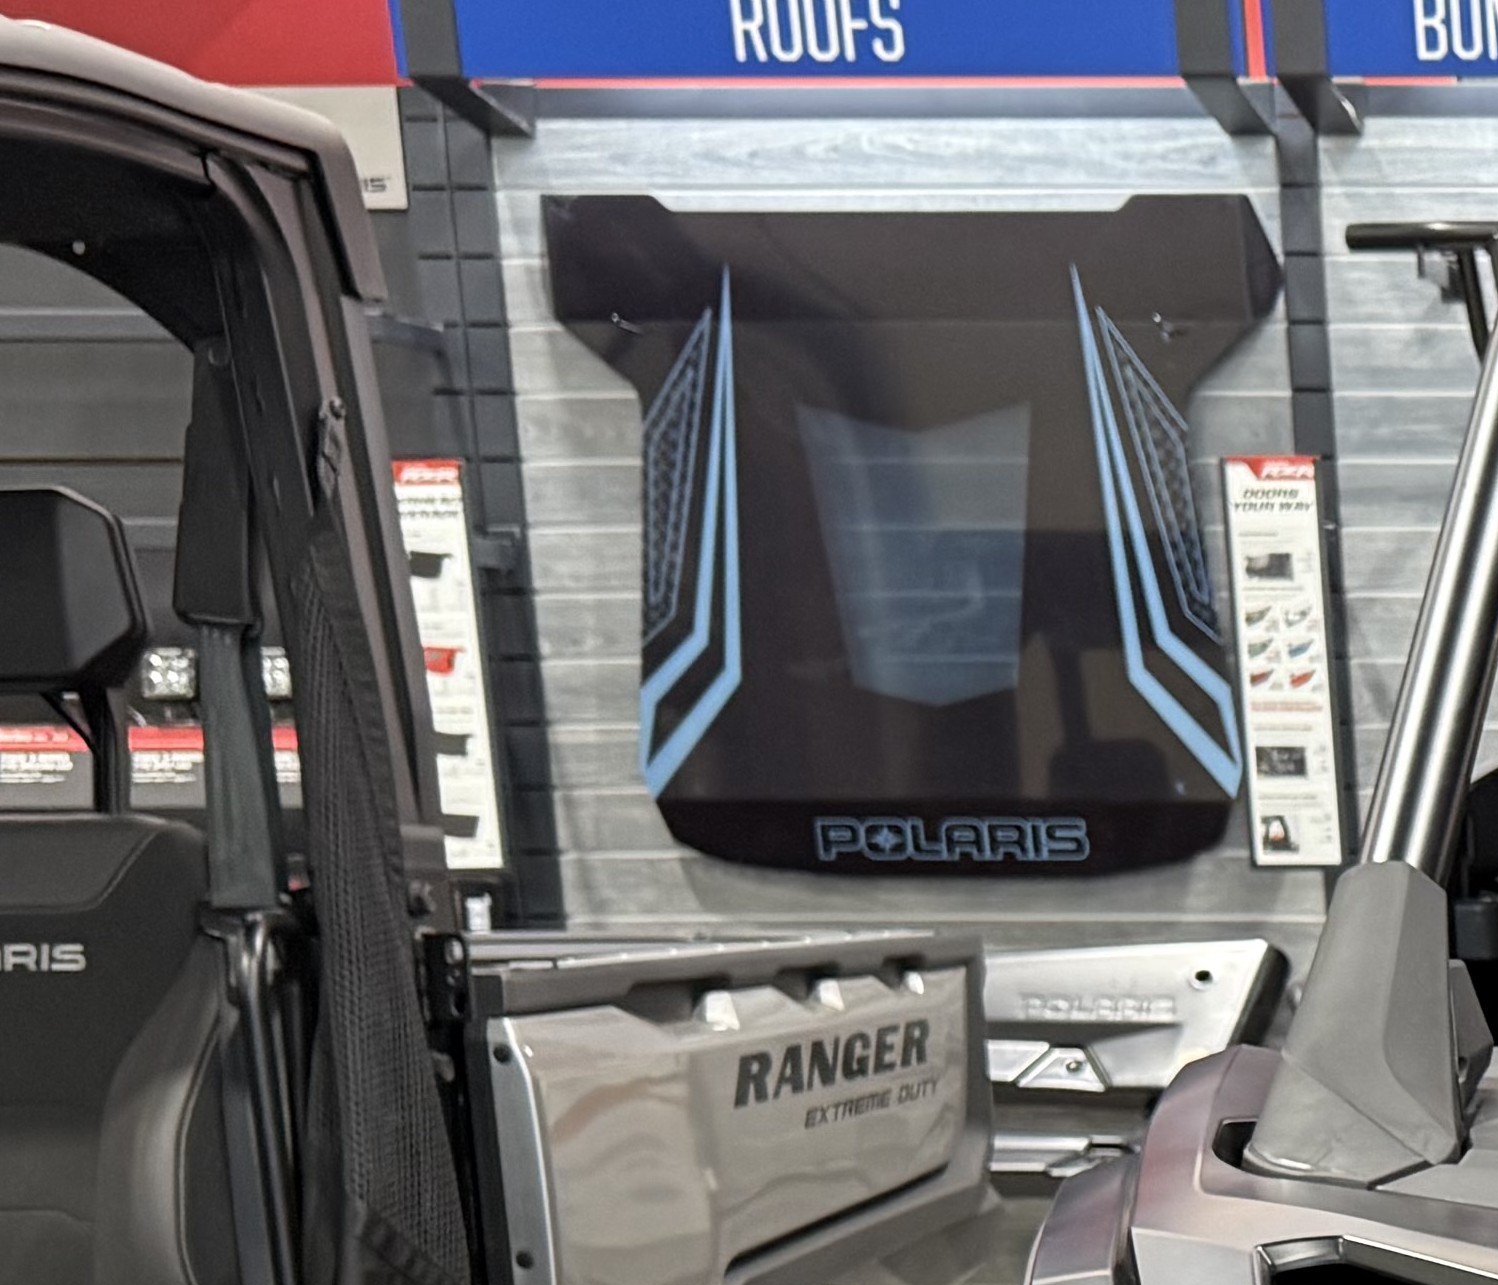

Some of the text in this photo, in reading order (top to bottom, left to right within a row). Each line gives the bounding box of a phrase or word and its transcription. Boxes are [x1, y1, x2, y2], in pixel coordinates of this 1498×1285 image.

[731, 0, 904, 63] ROOFS
[814, 816, 1090, 862] POLARIS
[734, 1018, 930, 1109] RANGER
[804, 1074, 941, 1130] EXTREME DUTY
